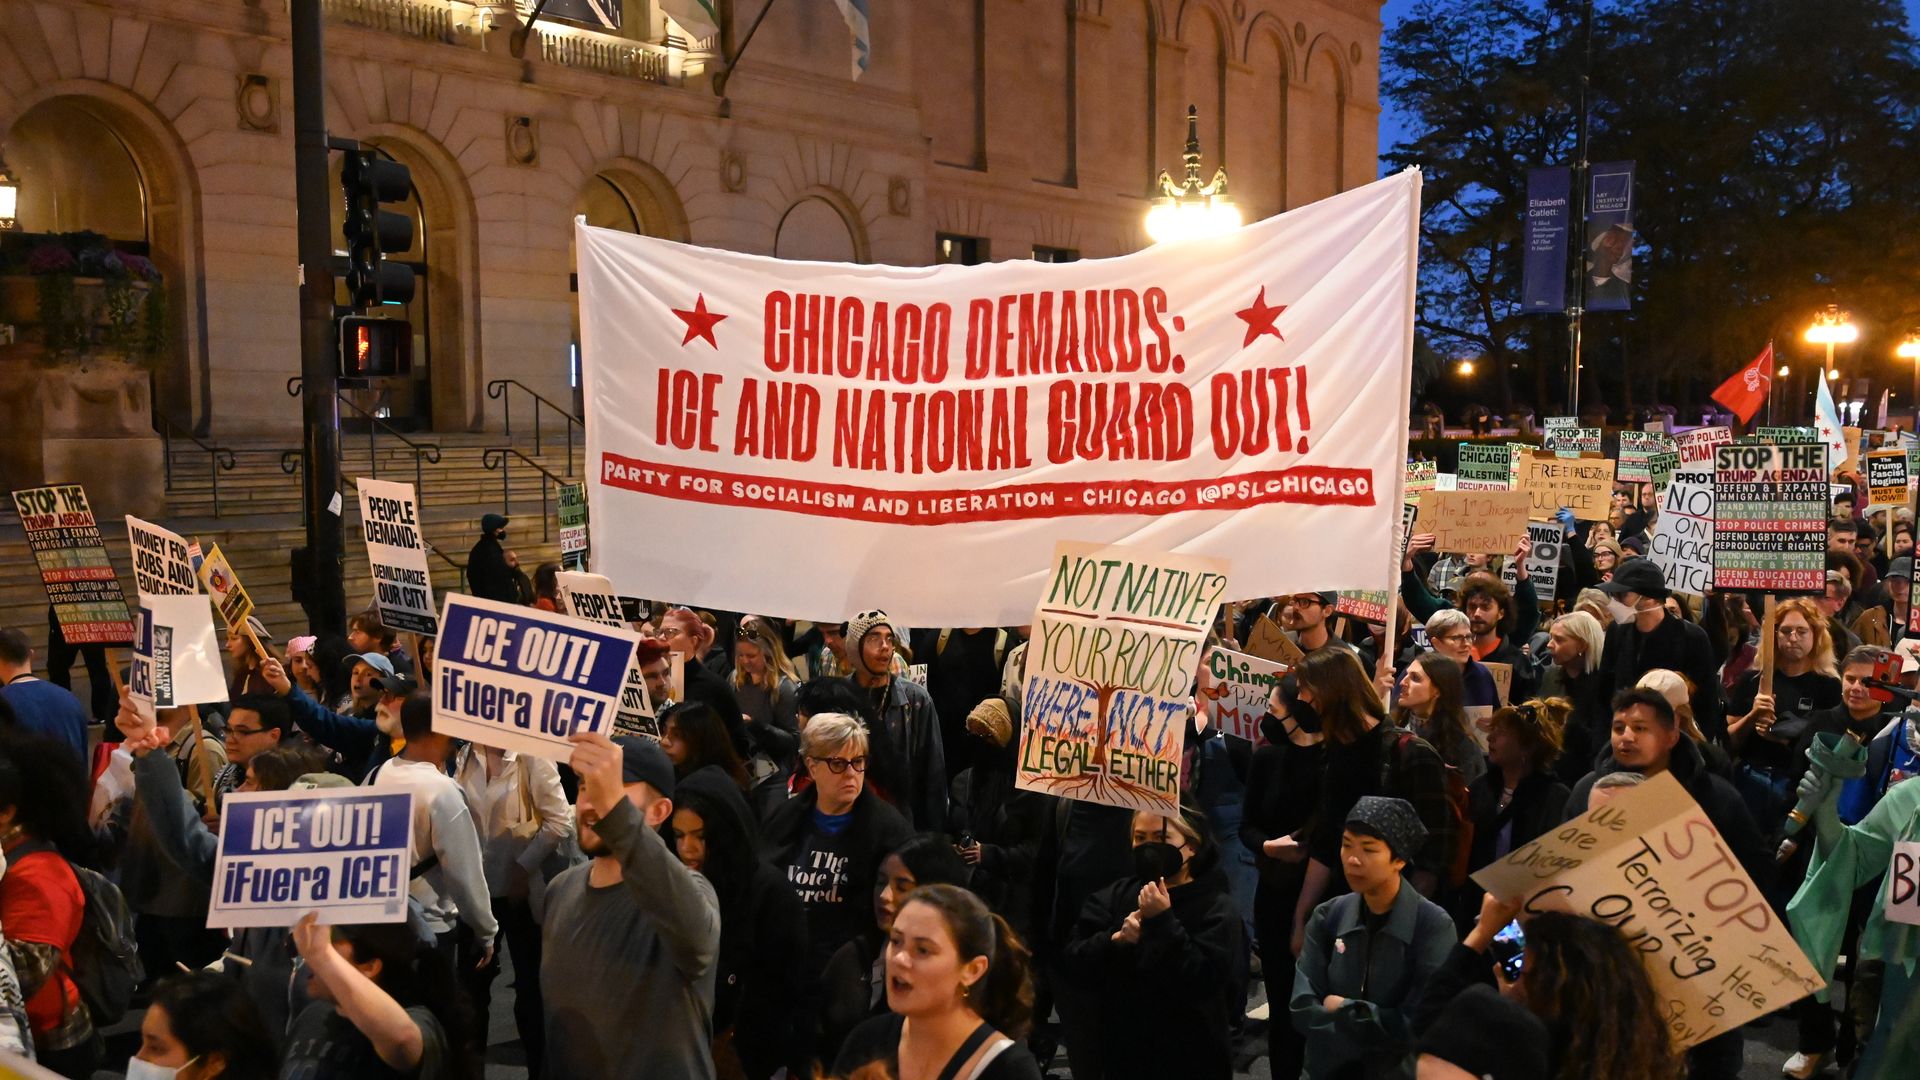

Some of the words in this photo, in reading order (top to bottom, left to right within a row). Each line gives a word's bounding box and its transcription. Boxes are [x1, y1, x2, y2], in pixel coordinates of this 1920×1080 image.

[1529, 197, 1566, 208] Elizabeth
[1529, 208, 1559, 217] Catlett:
[763, 290, 952, 385] CHICAGO
[964, 286, 1186, 380] DEMANDS:
[655, 368, 723, 452] ICE
[733, 378, 822, 462] AND
[832, 386, 1032, 474] NATIONAL
[1047, 380, 1194, 464] GUARD
[1210, 364, 1310, 460] OUT!
[1556, 429, 1580, 438] STOP
[1582, 429, 1599, 438] THE
[1622, 431, 1644, 440] STOP
[1646, 432, 1661, 440] THE
[1677, 435, 1695, 446] STOP
[1697, 429, 1730, 442] POLICE
[1422, 461, 1435, 470] THE
[1460, 452, 1508, 464] CHICAGO
[1717, 448, 1772, 470] STOP
[1778, 446, 1823, 469] THE
[1459, 469, 1507, 480] PALESTINE
[1530, 463, 1568, 479] FREE
[1716, 470, 1757, 482] TRUMP
[1762, 469, 1823, 482] AGENDA!
[1871, 469, 1905, 478] Fascist
[604, 459, 672, 487] PARTY
[680, 474, 723, 494] FOR
[732, 480, 854, 509] SOCIALISM
[862, 495, 909, 516] AND
[918, 490, 1055, 516] LIBERATION
[1083, 490, 1187, 507] CHICAGO
[1458, 482, 1507, 491] OCCUPATION
[1716, 484, 1757, 493] DEFEND
[1763, 484, 1769, 492] &
[1777, 483, 1827, 492] EXPAND
[1871, 477, 1906, 487] Regime
[16, 489, 58, 516] STOP
[58, 487, 88, 512] THE
[1564, 495, 1593, 510] ICE
[1667, 484, 1711, 516] NO
[1716, 493, 1776, 501] IMMIGRANT
[1783, 492, 1827, 501] RIGHTS
[368, 496, 415, 525] PEOPLE
[1716, 502, 1744, 511] STAND
[1748, 502, 1769, 511] WITH
[1773, 502, 1825, 511] PALESTINE
[22, 515, 55, 531] TRUMP
[59, 512, 93, 527] AGENDA!
[1716, 511, 1733, 519] END
[1737, 511, 1748, 519] US
[1752, 511, 1767, 519] AID
[1772, 511, 1784, 519] TO
[1788, 511, 1825, 519] ISRAEL
[1676, 518, 1707, 539] ON
[1715, 521, 1741, 530] STOP
[1744, 521, 1778, 530] POLICE
[1784, 521, 1825, 530] CRIMES
[28, 530, 60, 542] DEFEND
[71, 528, 100, 539] EXPAND
[365, 519, 420, 549] DEMAND:
[1715, 532, 1749, 541] DEFEND
[1752, 533, 1800, 541] LGBTQIA+
[1803, 533, 1826, 541] AND
[31, 540, 75, 551] IMMIGRANT
[78, 537, 104, 547] RIGHTS
[131, 526, 166, 554] MONEY
[168, 537, 189, 565] FOR
[1714, 542, 1783, 551] REPRODUCTIVE
[1787, 542, 1825, 551] RIGHTS
[1715, 552, 1741, 560] DEFEND
[1782, 552, 1810, 560] RIGHTS
[1813, 552, 1825, 560] TO
[135, 549, 165, 578] JOBS
[168, 560, 194, 589] AND
[1526, 563, 1553, 573] LAS
[1715, 560, 1763, 568] UNIONIZE
[1769, 561, 1776, 569] &
[1783, 561, 1825, 569] STRIKE
[42, 570, 62, 582] STOP
[65, 568, 89, 580] POLICE
[91, 567, 115, 578] CRIMES
[372, 563, 427, 586] DEMILITARIZE
[1714, 570, 1749, 578] DEFEND
[1753, 571, 1811, 580] EDUCATION
[1816, 572, 1823, 580] &
[47, 582, 73, 593] DEFEND
[106, 581, 120, 590] AND
[1048, 555, 1122, 611] NOT
[1112, 562, 1227, 625] NATIVE?
[1714, 578, 1766, 587] ACADEMIC
[1771, 580, 1824, 589] FREEDOM
[50, 593, 99, 604] REPRODUCTIVE
[101, 592, 123, 601] RIGHTS
[378, 582, 403, 605] OUR
[402, 586, 428, 610] CITY
[571, 592, 624, 620] PEOPLE
[61, 623, 89, 634] DEFEND
[90, 622, 128, 633] EDUCATION
[64, 632, 104, 643] ACADEMIC
[463, 615, 516, 667] ICE
[517, 627, 600, 685] OUT!
[1041, 620, 1112, 686] YOUR
[1111, 628, 1197, 698] ROOTS
[163, 649, 171, 699] COALITION
[1023, 675, 1098, 741] WERE
[1105, 691, 1187, 754] NOT
[1022, 730, 1100, 776] LEGAL
[1109, 749, 1178, 794] EITHER
[251, 806, 301, 851] ICE
[310, 802, 383, 848] OUT!
[1558, 827, 1597, 850] are
[810, 850, 849, 874] The
[1507, 841, 1582, 878] Chicago
[339, 854, 399, 899] ICE!
[787, 864, 827, 886] Vote
[1663, 815, 1771, 933] STOP
[1616, 836, 1717, 980] Terrorizing
[1722, 965, 1768, 1011] Here
[1701, 991, 1726, 1018] to
